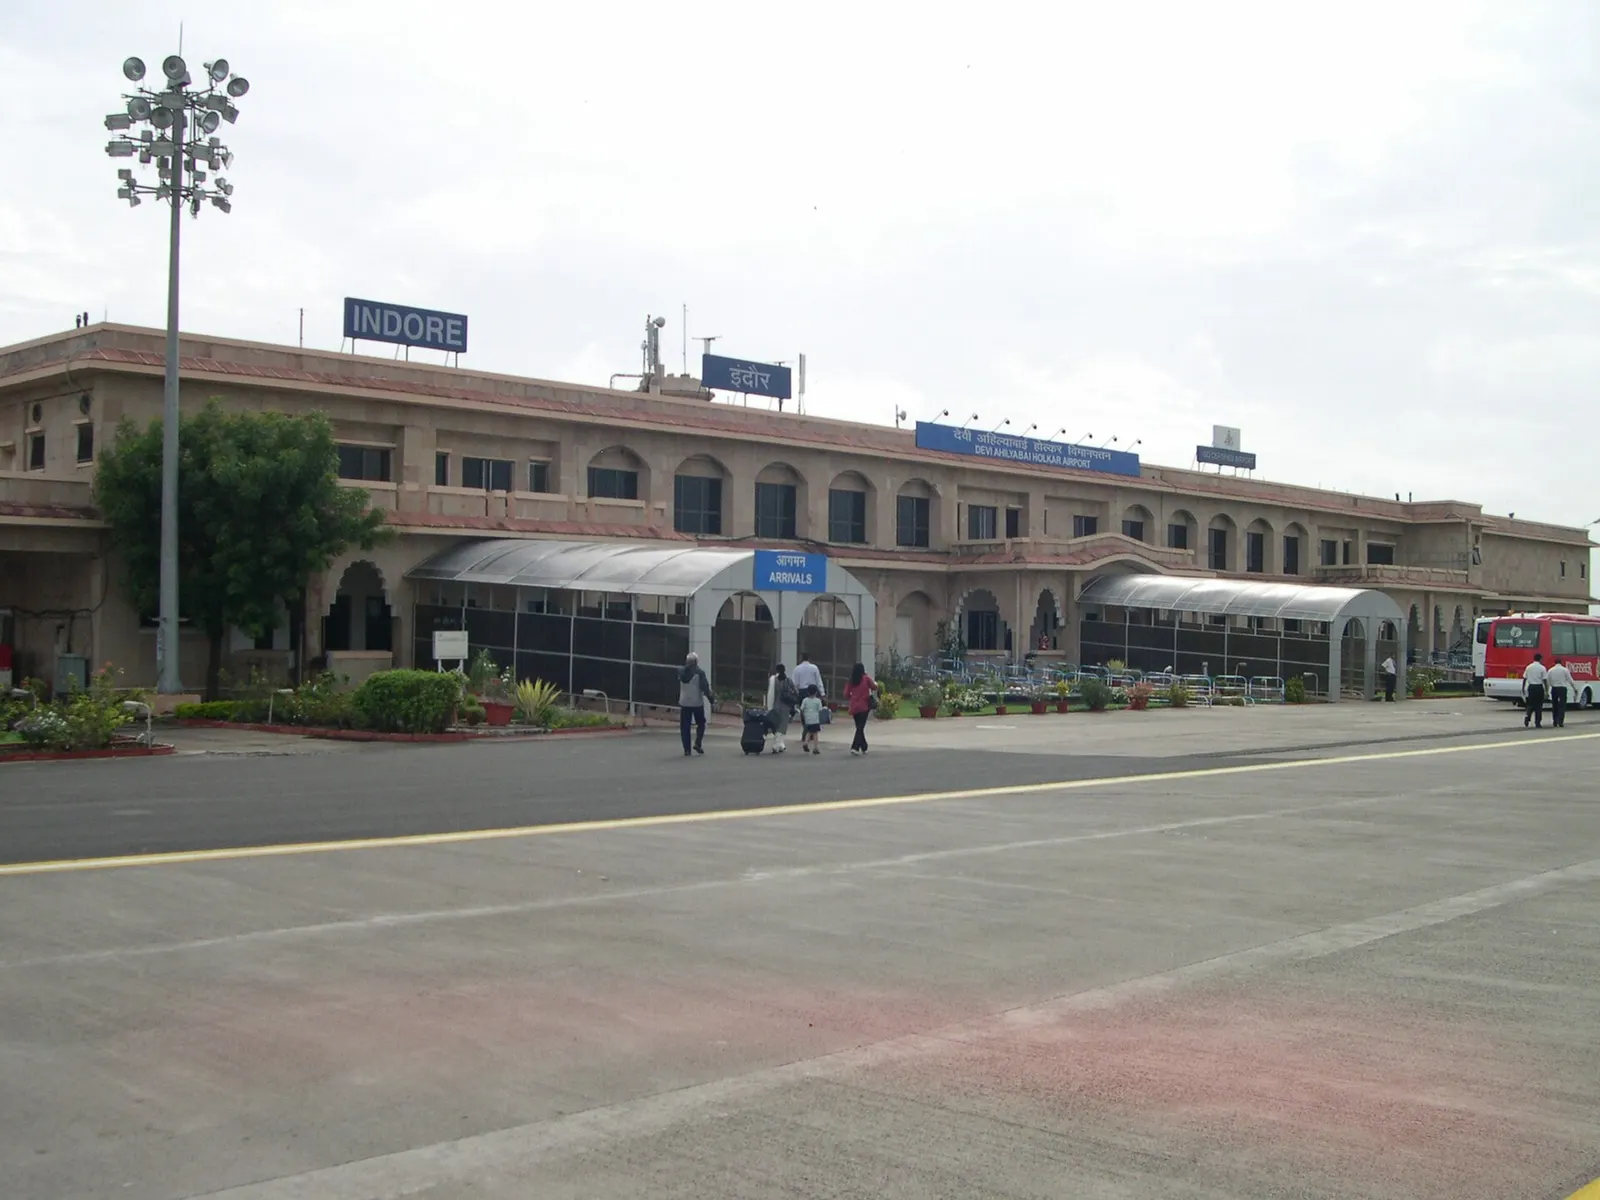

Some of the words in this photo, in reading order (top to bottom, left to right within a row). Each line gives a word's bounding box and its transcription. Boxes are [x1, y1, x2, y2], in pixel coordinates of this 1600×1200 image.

[353, 305, 463, 346] INDORE
[729, 363, 771, 390] इंदौर
[953, 427, 972, 442] देवी
[974, 444, 993, 456] DEVI
[994, 447, 1031, 463] AHILYABAI
[1032, 451, 1061, 465] HOLKAR
[1063, 456, 1091, 469] AIRPORT
[776, 554, 806, 568] आगमन
[769, 571, 813, 585] ARRIVALS
